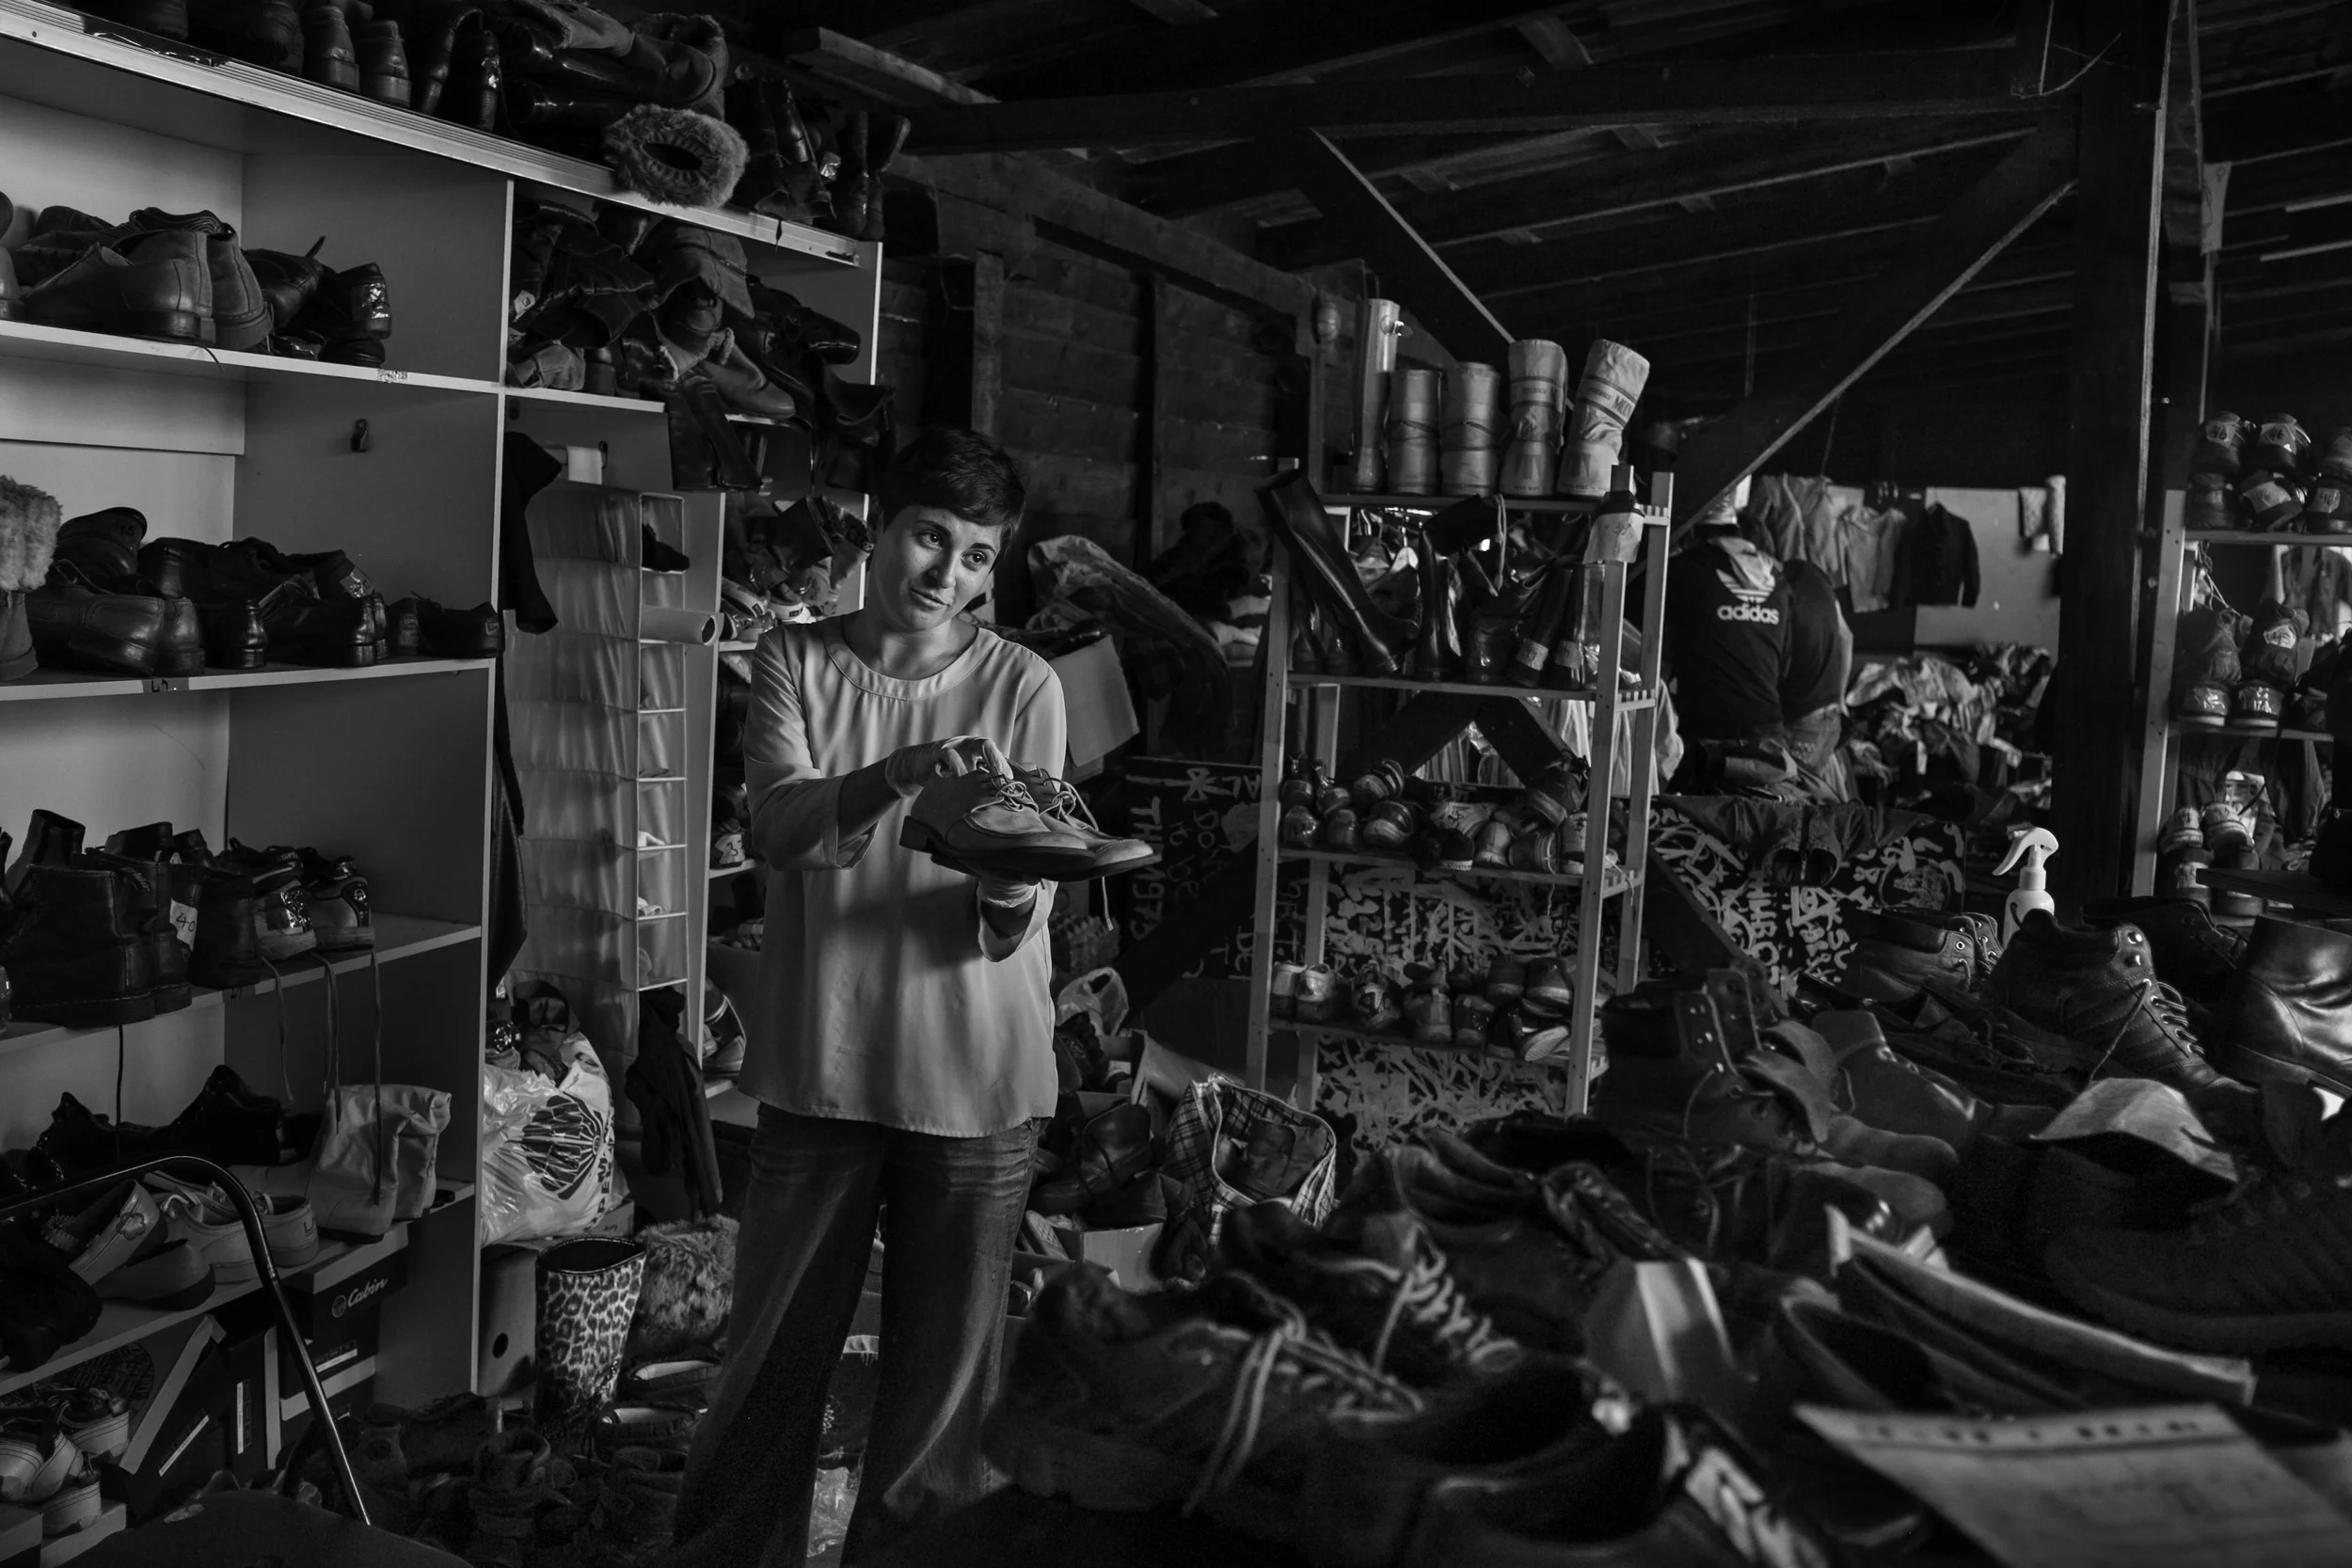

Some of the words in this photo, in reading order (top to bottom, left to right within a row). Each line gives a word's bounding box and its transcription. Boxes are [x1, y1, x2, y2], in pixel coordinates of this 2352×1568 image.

[1716, 602, 1779, 626] adidas
[176, 913, 195, 932] 40
[347, 1277, 389, 1307] Cabin
